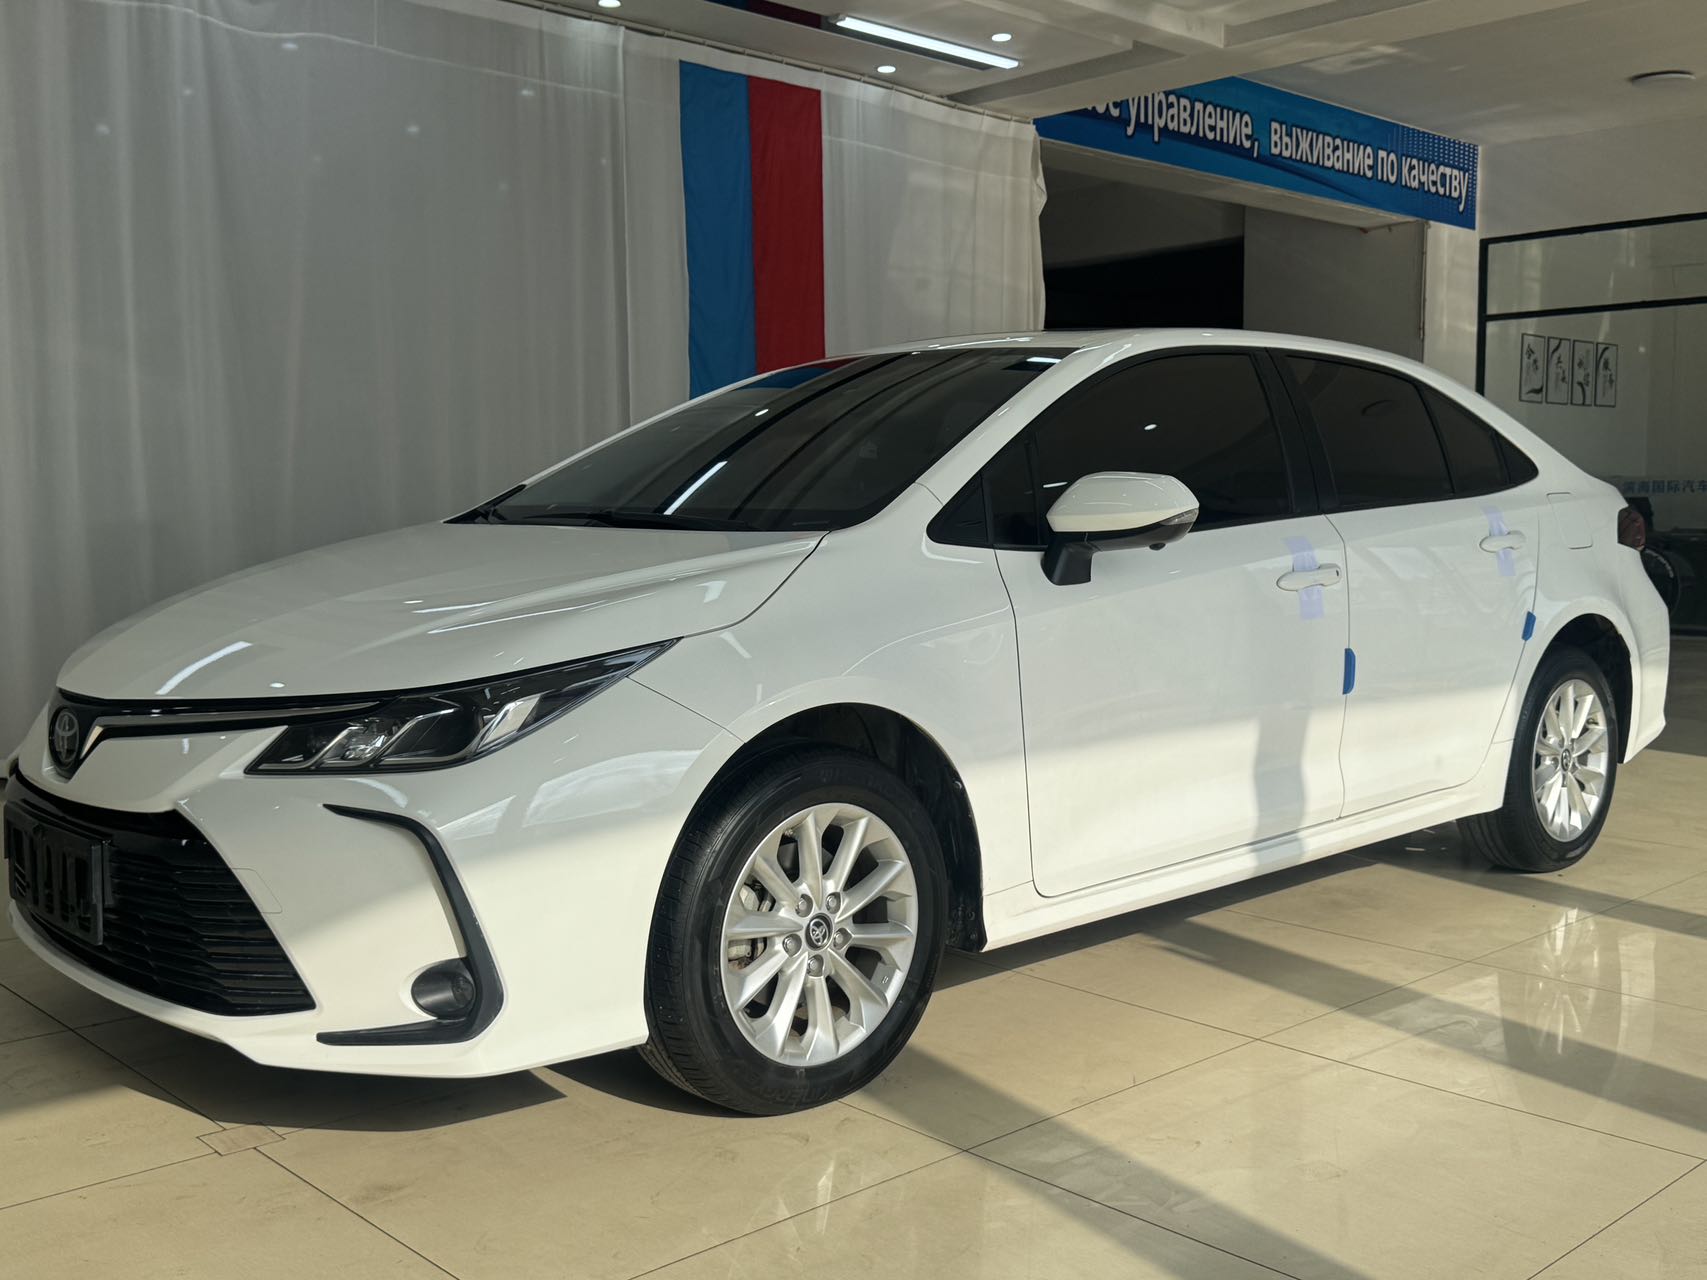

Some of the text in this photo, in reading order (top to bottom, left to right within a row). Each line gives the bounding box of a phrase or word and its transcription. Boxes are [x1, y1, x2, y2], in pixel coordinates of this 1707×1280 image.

[1126, 91, 1469, 212] управление, выживание по качеству
